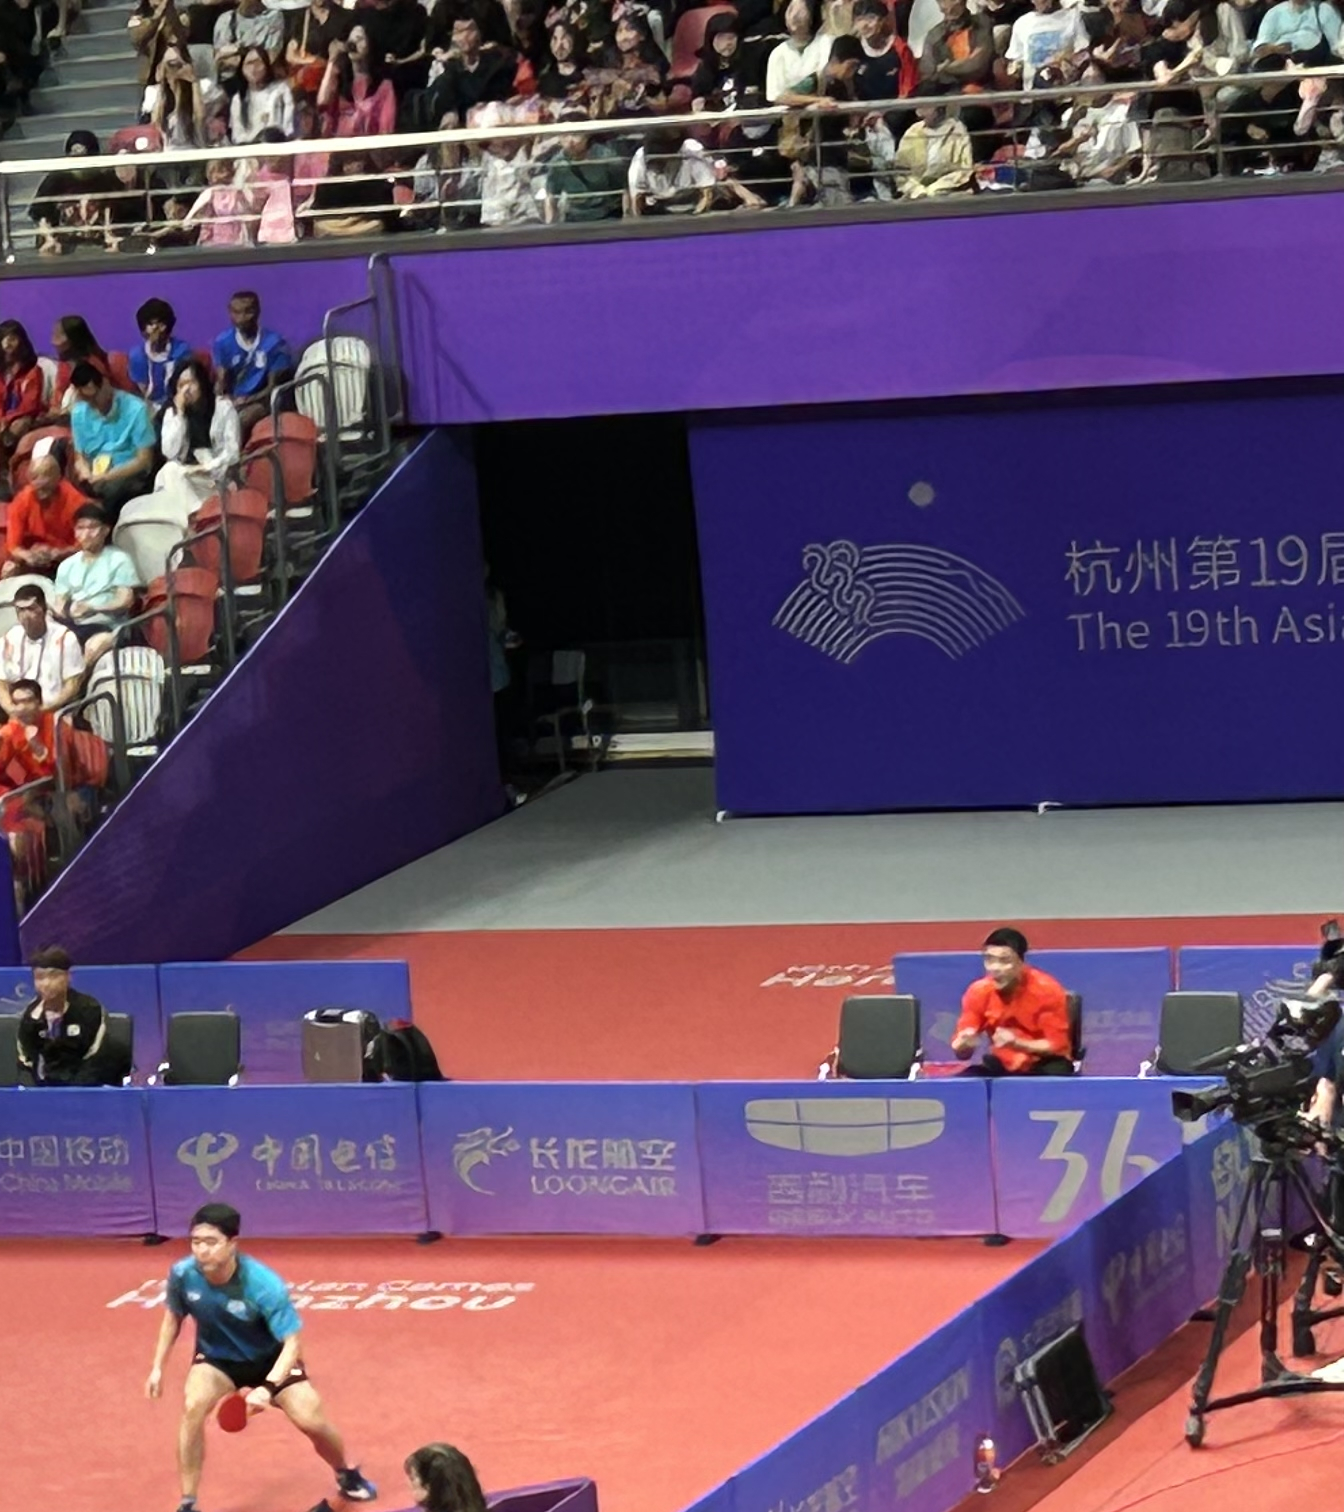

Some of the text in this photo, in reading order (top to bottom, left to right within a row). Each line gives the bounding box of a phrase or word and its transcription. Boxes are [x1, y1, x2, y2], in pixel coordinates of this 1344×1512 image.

[1067, 602, 1344, 650] The 19th Asi
[530, 1175, 678, 1197] LOONGAIR
